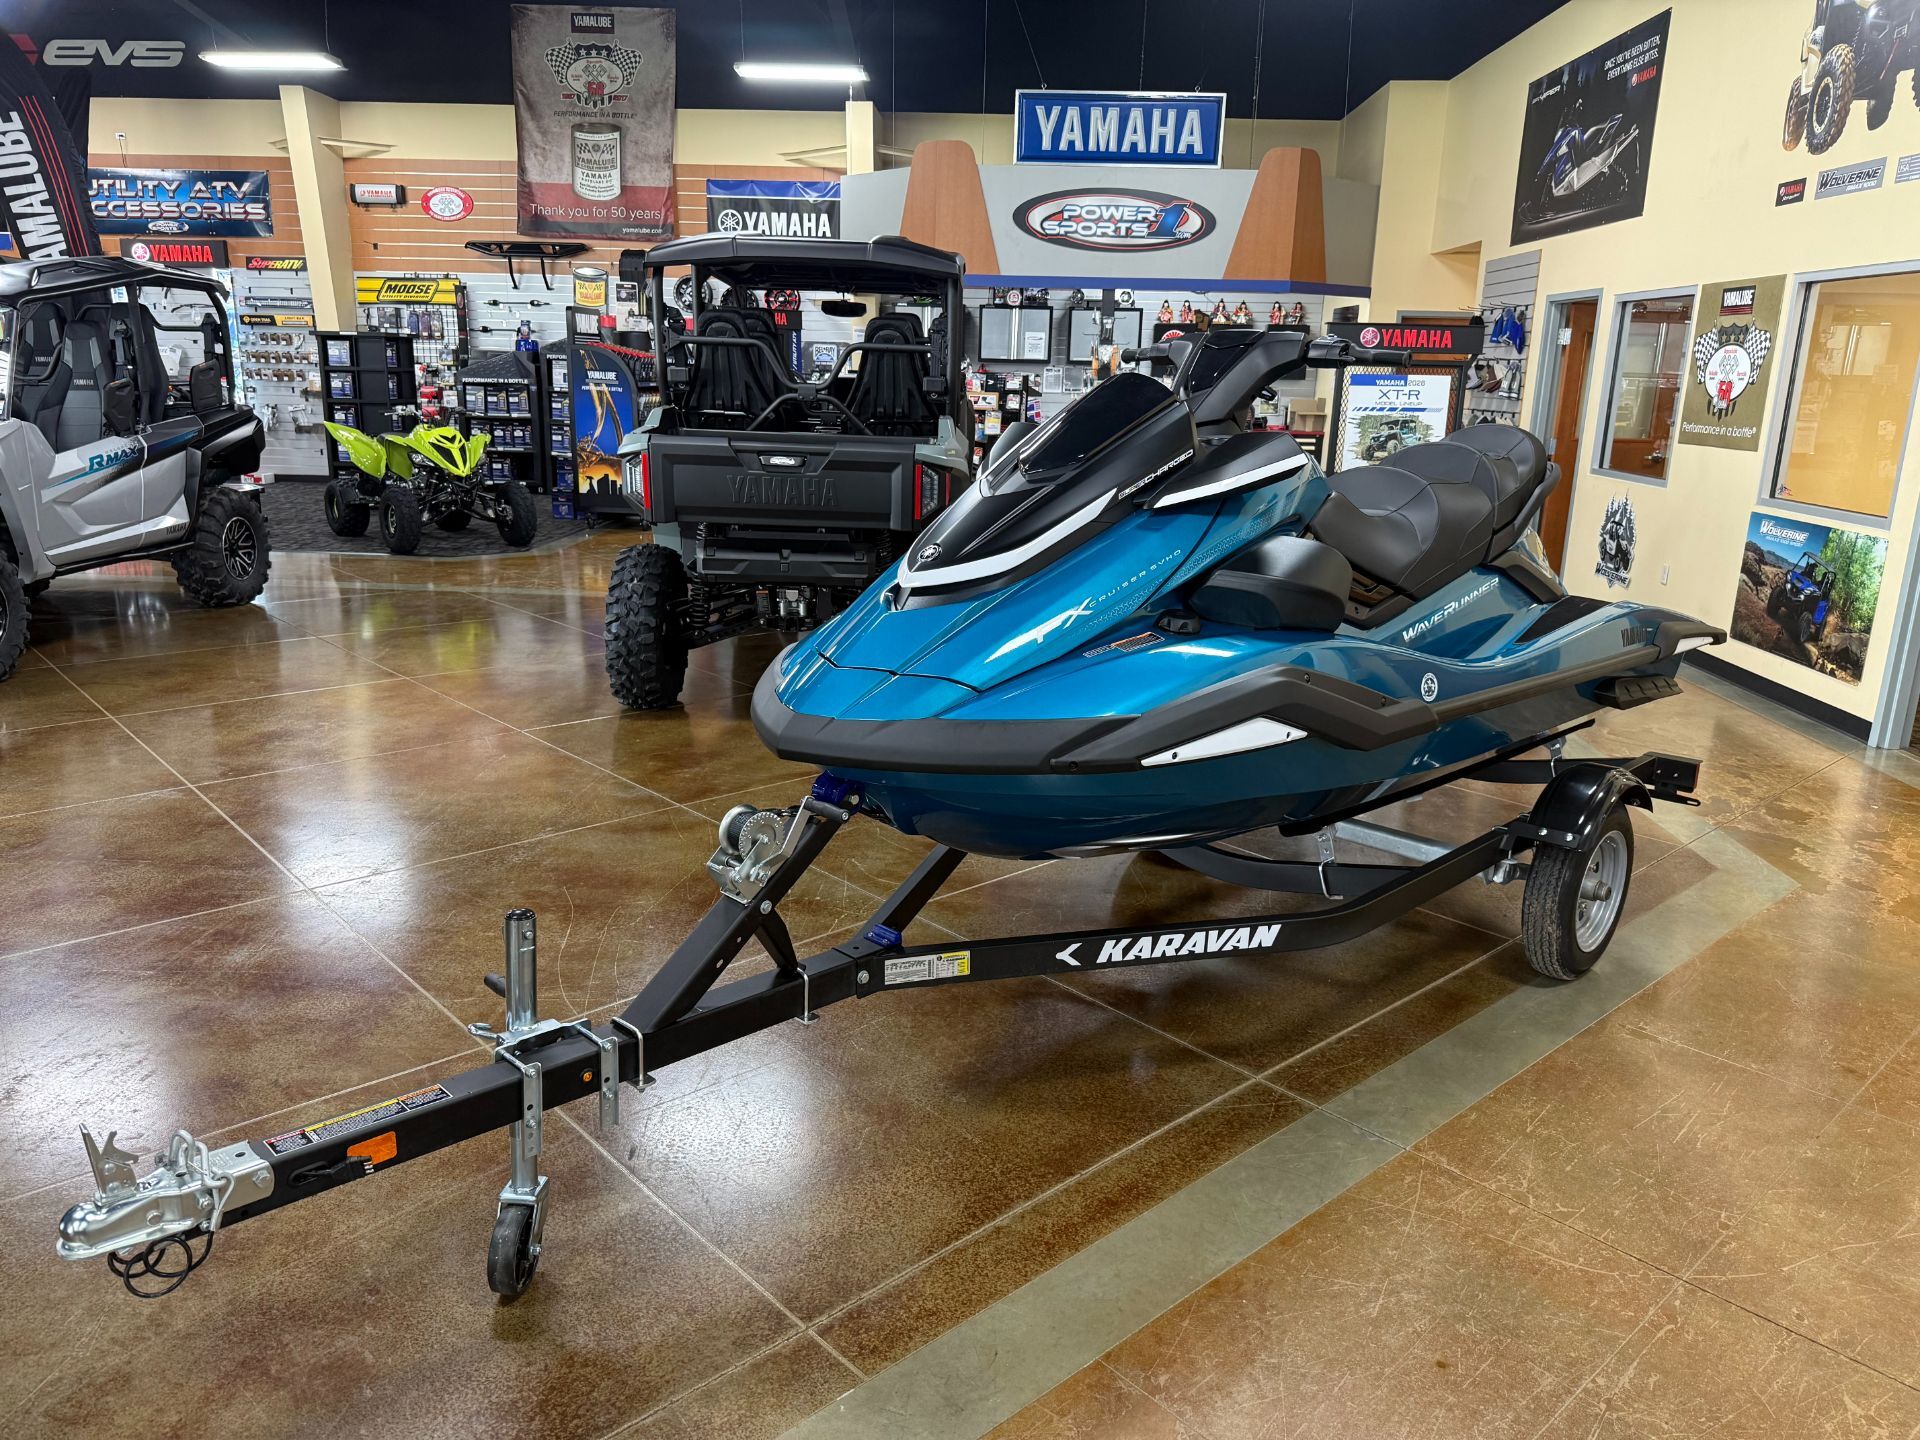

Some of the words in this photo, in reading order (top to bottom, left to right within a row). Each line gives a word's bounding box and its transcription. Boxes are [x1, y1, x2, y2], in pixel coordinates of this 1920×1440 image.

[573, 15, 613, 28] YAMALUBE
[553, 110, 599, 118] PERFORMANCE
[1035, 105, 1203, 155] YAMAHA
[580, 171, 613, 179] YAMAHA
[1818, 166, 1883, 191] WOLVERINE
[0, 111, 69, 261] AMALUBE
[189, 181, 251, 199] ATV
[91, 200, 267, 220] CCESSORIES
[529, 203, 565, 217] Thank
[568, 208, 590, 218] you
[592, 206, 609, 217] for
[611, 207, 626, 218] 50
[629, 208, 661, 221] years
[1063, 205, 1158, 221] POWER
[743, 211, 832, 238] YAMAHA
[1044, 221, 1148, 237] SPORTS
[149, 244, 213, 263] YAMAHA
[248, 257, 304, 269] SUPERATV
[384, 283, 433, 295] MOOSE
[1723, 289, 1755, 307] YAMALUBE
[1381, 328, 1453, 348] YAMAHA
[73, 378, 95, 386] YAMAHA
[587, 370, 617, 381] YAMALUBE
[1375, 379, 1406, 387] YAMAHA
[1378, 389, 1421, 401] XT-R
[1681, 421, 1720, 435] Performance
[1720, 425, 1727, 435] in
[1726, 427, 1733, 436] a
[88, 445, 139, 473] RMAX
[726, 475, 838, 507] YAMAHA
[1760, 520, 1809, 541] WOLVERINE
[1595, 562, 1628, 585] WOLVERINE
[1089, 570, 1146, 608] CRUISER
[1402, 577, 1499, 642] WAVERUNNER
[1096, 924, 1283, 964] KARAVAN
